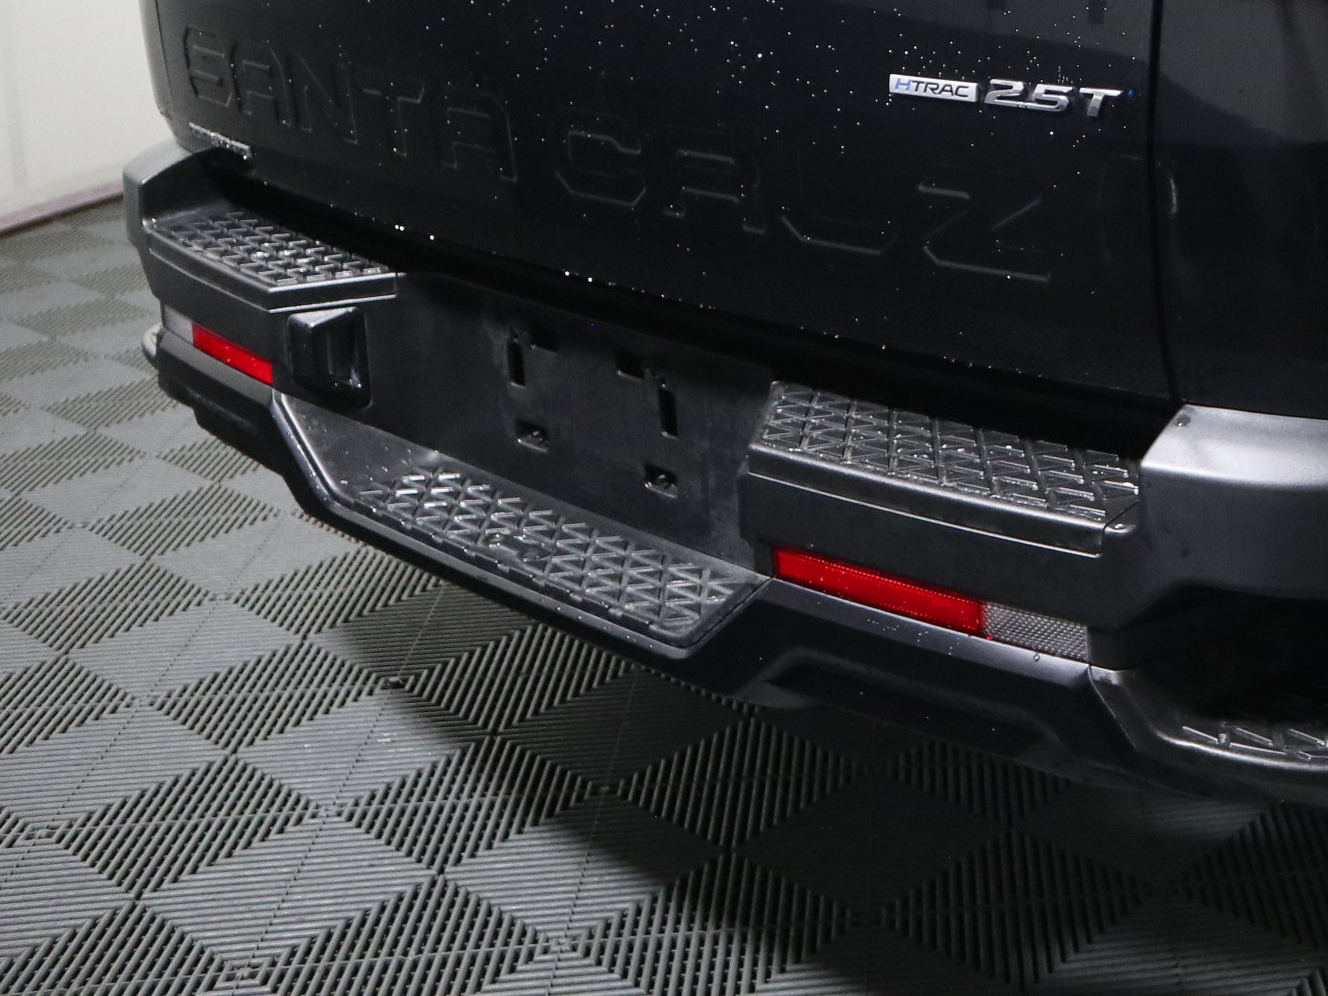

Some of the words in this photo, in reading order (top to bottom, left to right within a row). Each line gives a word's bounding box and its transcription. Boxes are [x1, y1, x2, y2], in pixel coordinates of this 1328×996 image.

[184, 26, 522, 184] SANTA
[555, 107, 1053, 284] CRUZ
[894, 77, 970, 99] HTRAC
